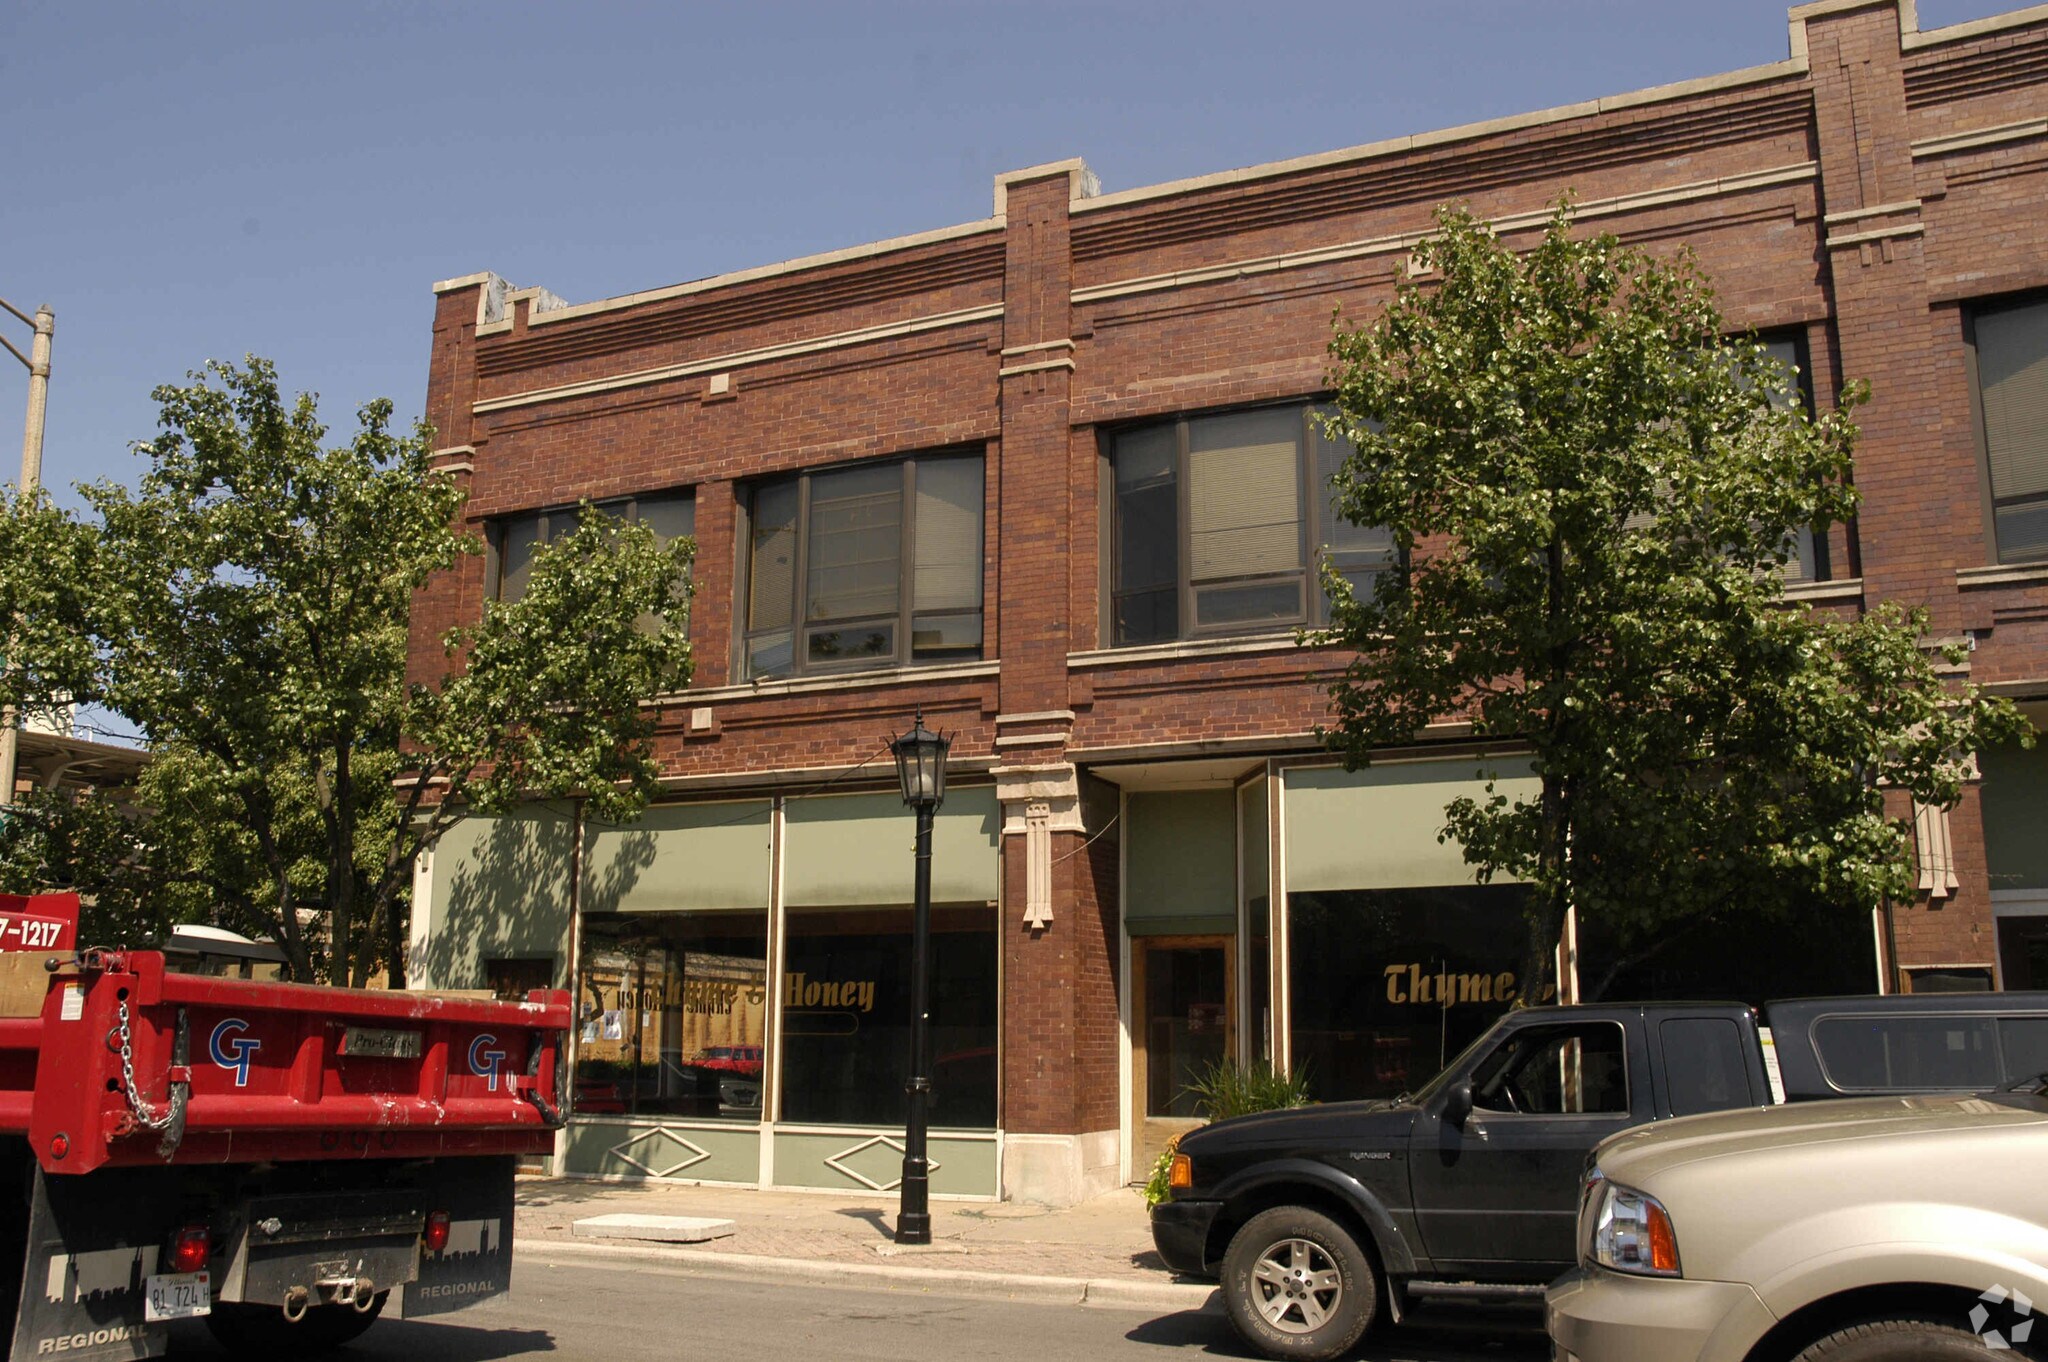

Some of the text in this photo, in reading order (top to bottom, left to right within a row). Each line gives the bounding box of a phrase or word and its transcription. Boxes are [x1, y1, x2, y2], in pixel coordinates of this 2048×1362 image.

[0, 918, 62, 947] 7-1217
[784, 972, 875, 1012] Honey
[1384, 963, 1516, 1009] Thyme
[153, 1288, 167, 1310] 81
[175, 1286, 198, 1308] 724
[420, 1280, 495, 1299] REGIONAL
[38, 1324, 148, 1354] REGIONAL
